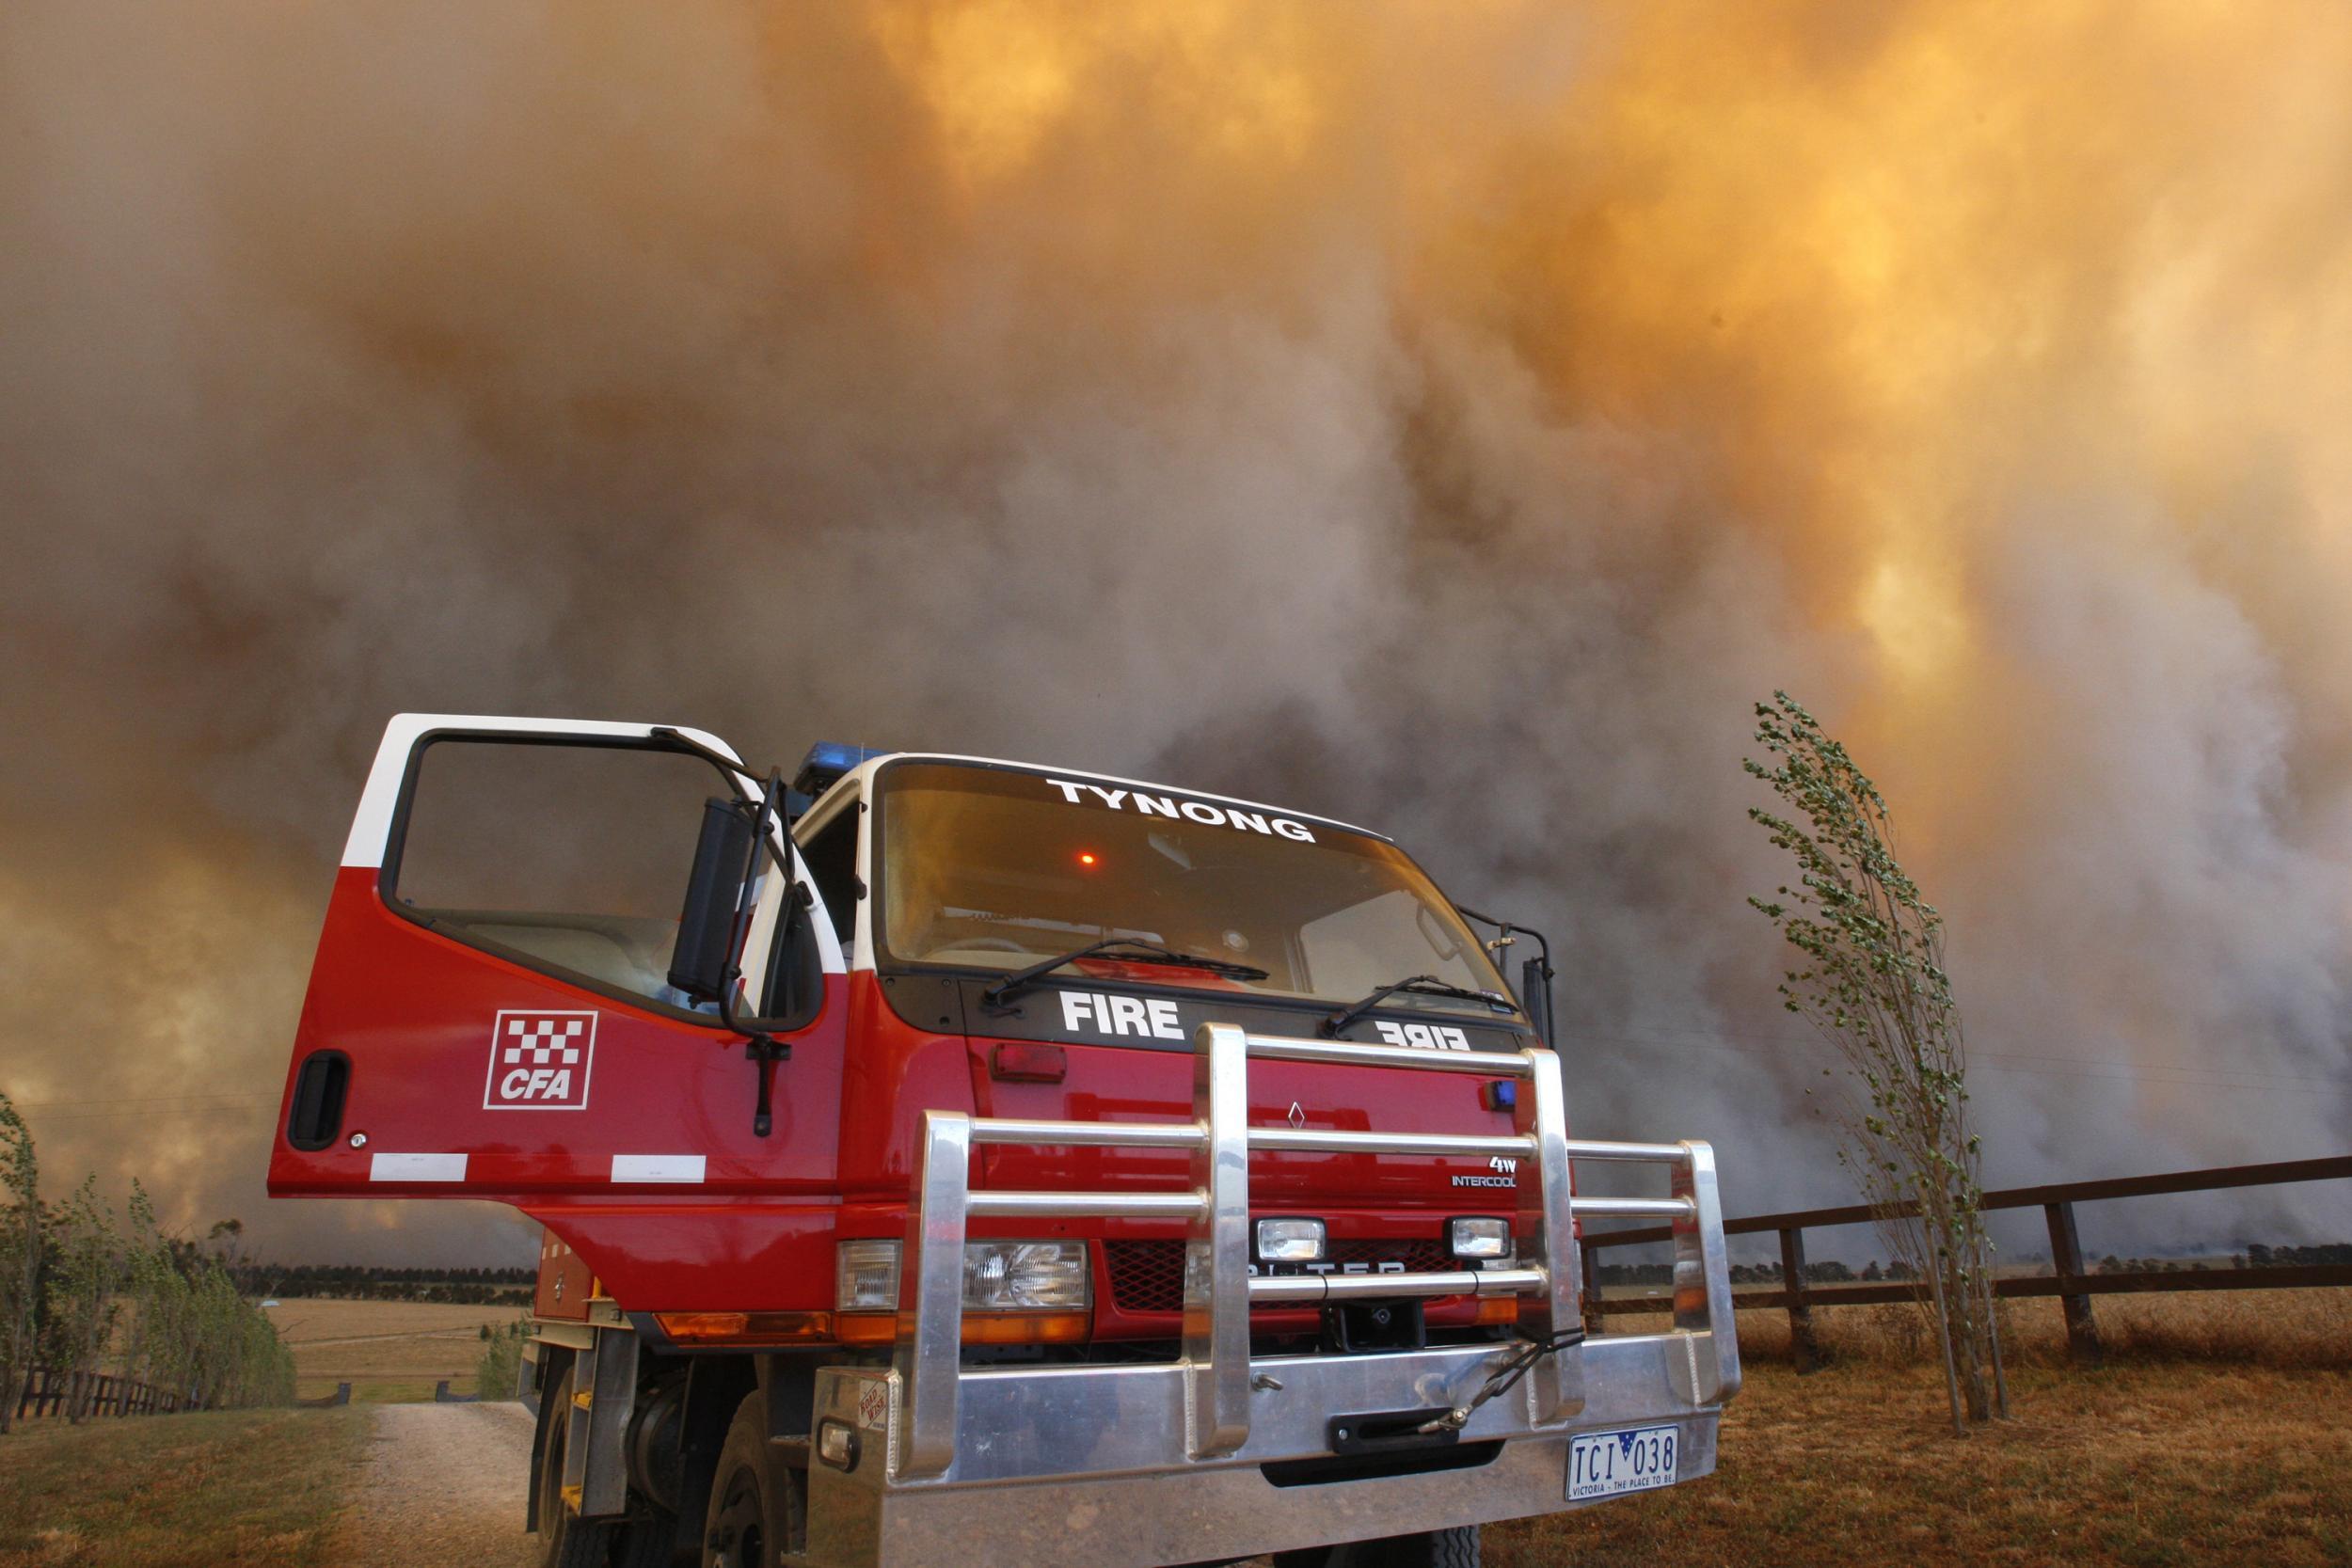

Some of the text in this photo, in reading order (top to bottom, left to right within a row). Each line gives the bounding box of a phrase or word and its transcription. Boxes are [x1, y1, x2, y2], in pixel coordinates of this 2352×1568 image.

[1045, 778, 1317, 844] TYNONG
[1058, 990, 1185, 1040] FIRE
[500, 1069, 571, 1100] CFA
[1575, 1435, 1674, 1484] TCI 038
[1572, 1483, 1605, 1497] VICTORIA
[1614, 1481, 1627, 1490] THE
[1629, 1478, 1650, 1488] PLACE
[1652, 1475, 1661, 1484] TO
